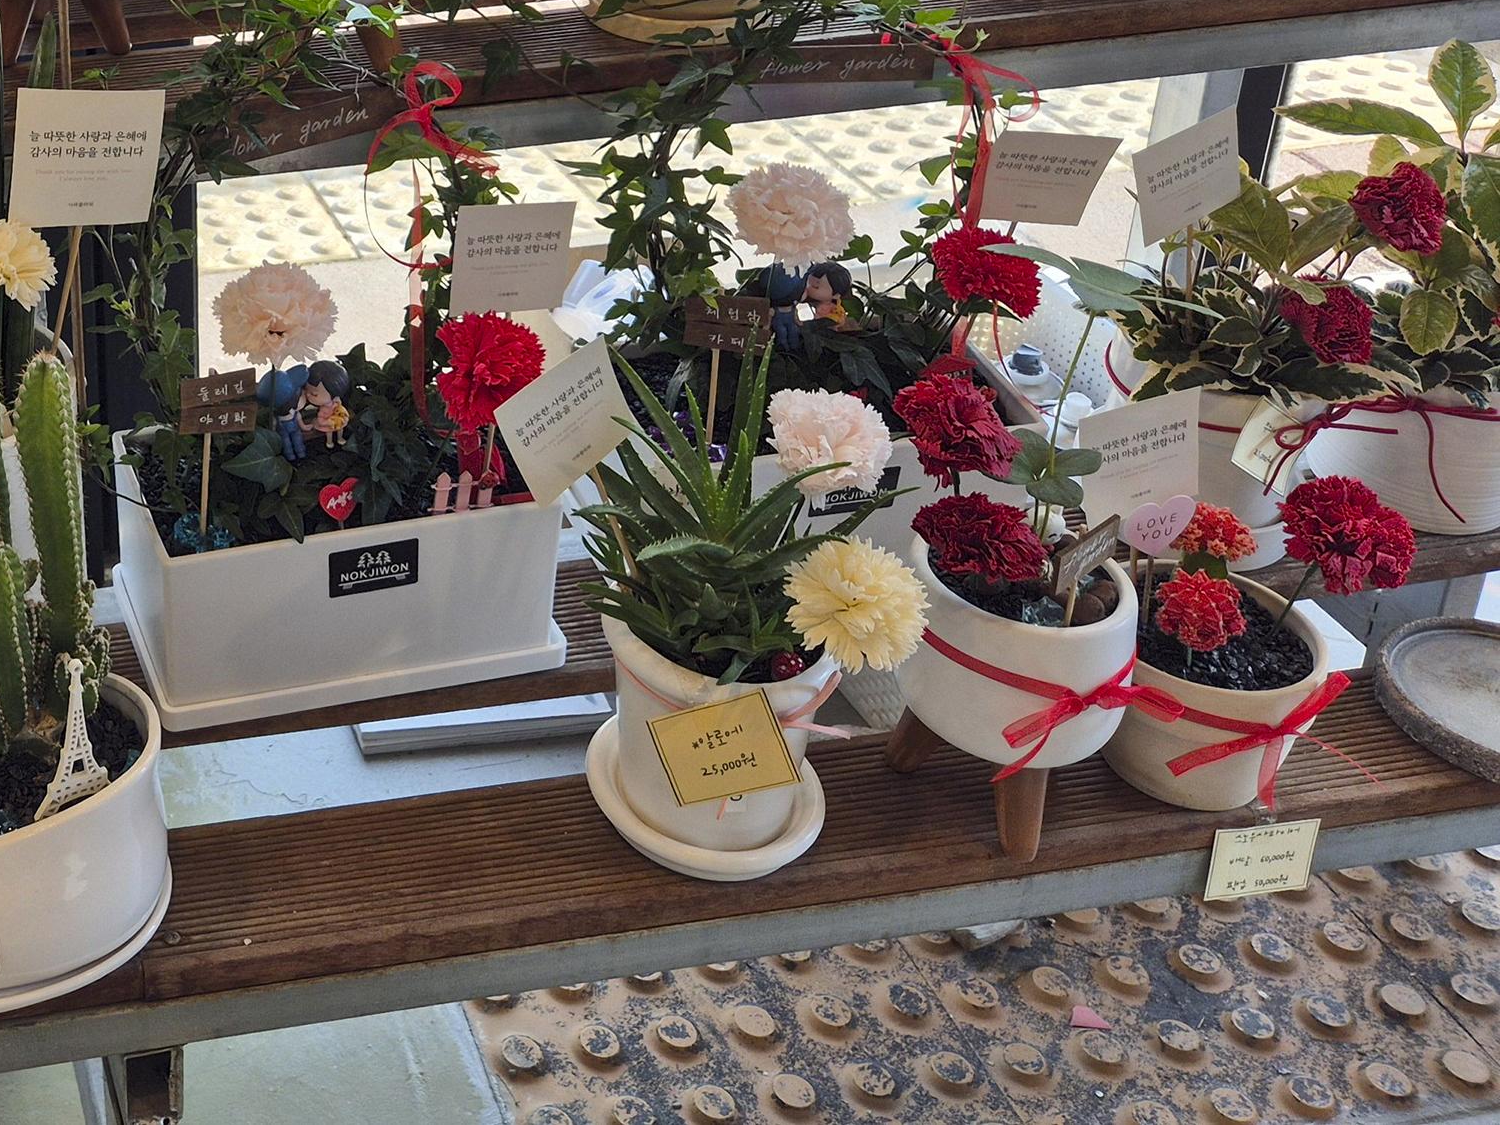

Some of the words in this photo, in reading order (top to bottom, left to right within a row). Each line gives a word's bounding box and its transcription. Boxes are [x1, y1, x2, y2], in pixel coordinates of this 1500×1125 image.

[760, 58, 831, 79] flower
[840, 54, 914, 79] garden
[300, 107, 368, 145] garden
[29, 131, 41, 142] 늘
[44, 130, 77, 143] 따뜻한
[80, 131, 112, 143] 사랑과
[115, 130, 147, 143] 은혜에
[30, 146, 62, 158] 감사의
[66, 146, 98, 159] 마음을
[102, 146, 144, 158] 전합니다
[1137, 513, 1178, 531] LOVE
[1141, 528, 1172, 541] YOU
[340, 562, 409, 582] NOKJIWON
[701, 752, 757, 776] 25,000원
